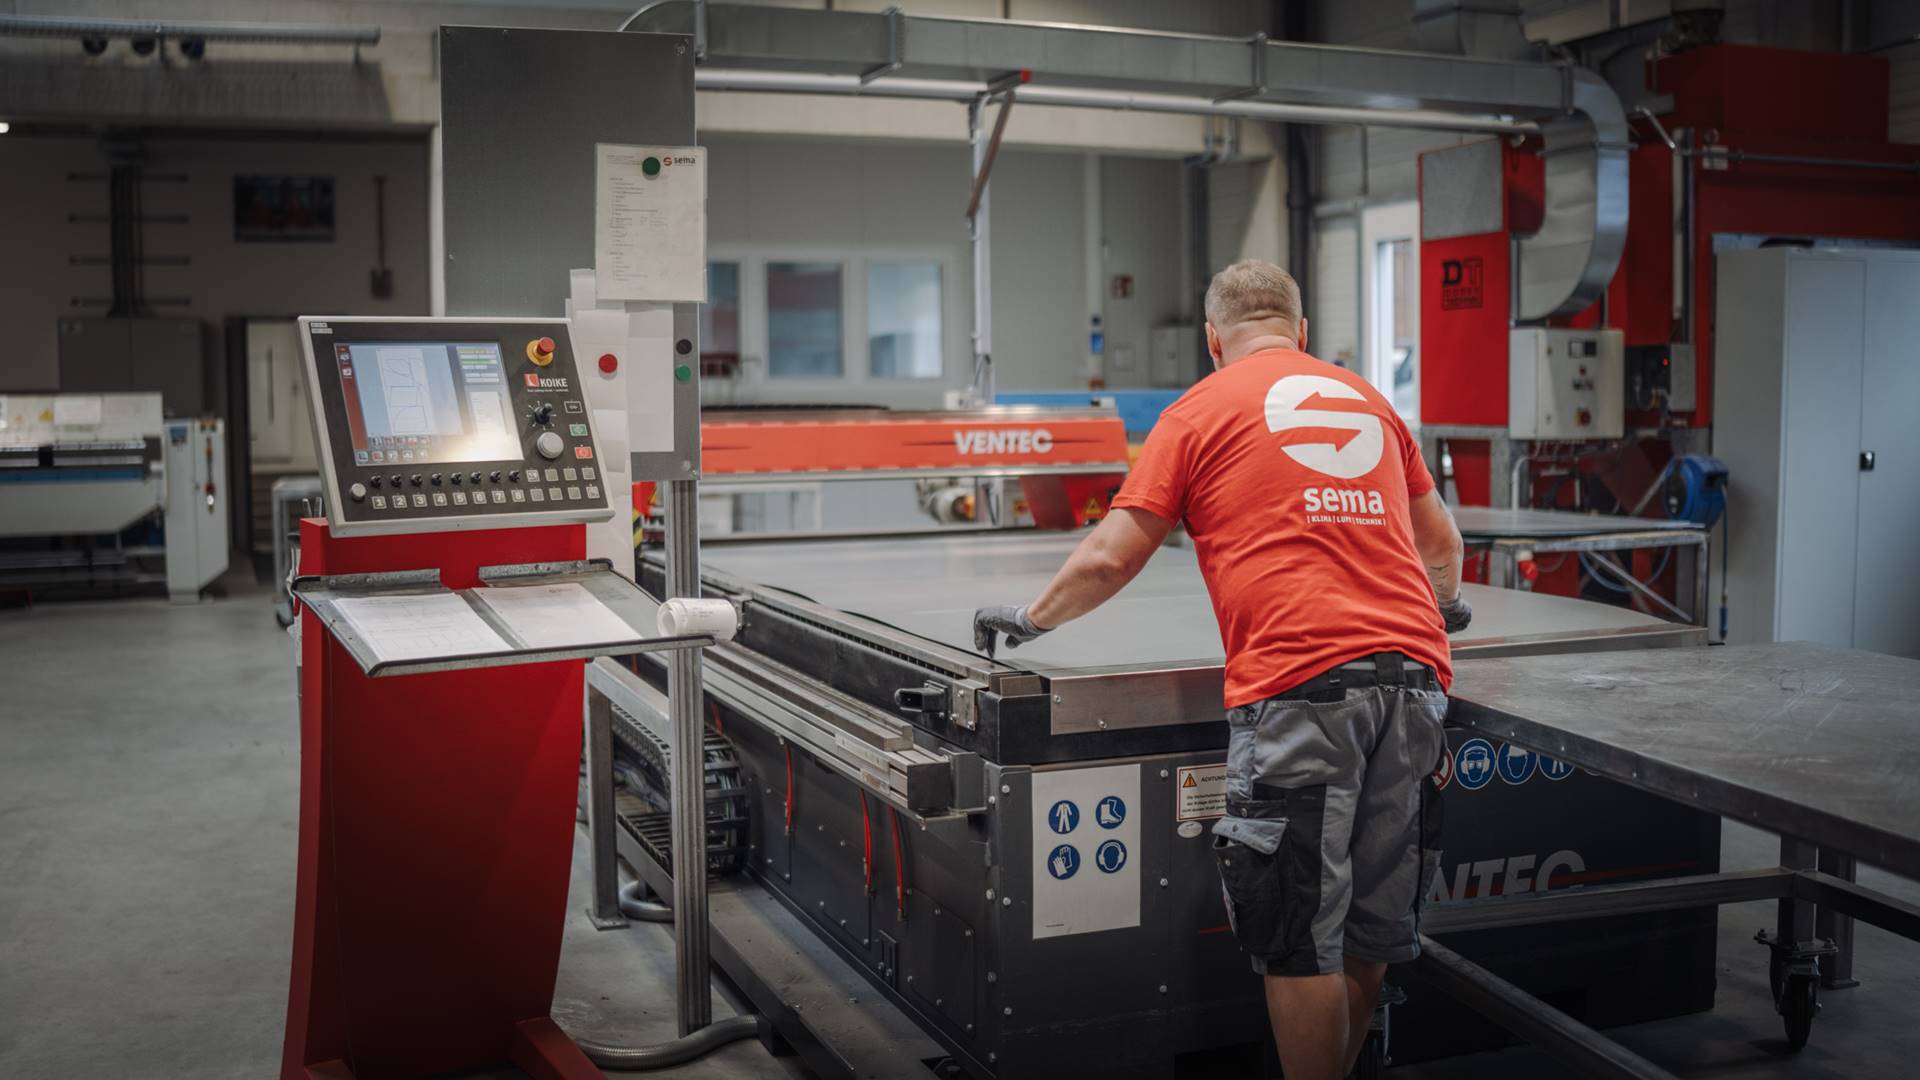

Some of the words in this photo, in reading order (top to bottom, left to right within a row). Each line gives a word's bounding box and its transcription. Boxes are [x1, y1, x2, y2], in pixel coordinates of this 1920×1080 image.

[673, 156, 696, 164] sema
[540, 378, 568, 387] KOIKE
[954, 429, 1053, 455] VENTEC
[1303, 487, 1385, 515] sema
